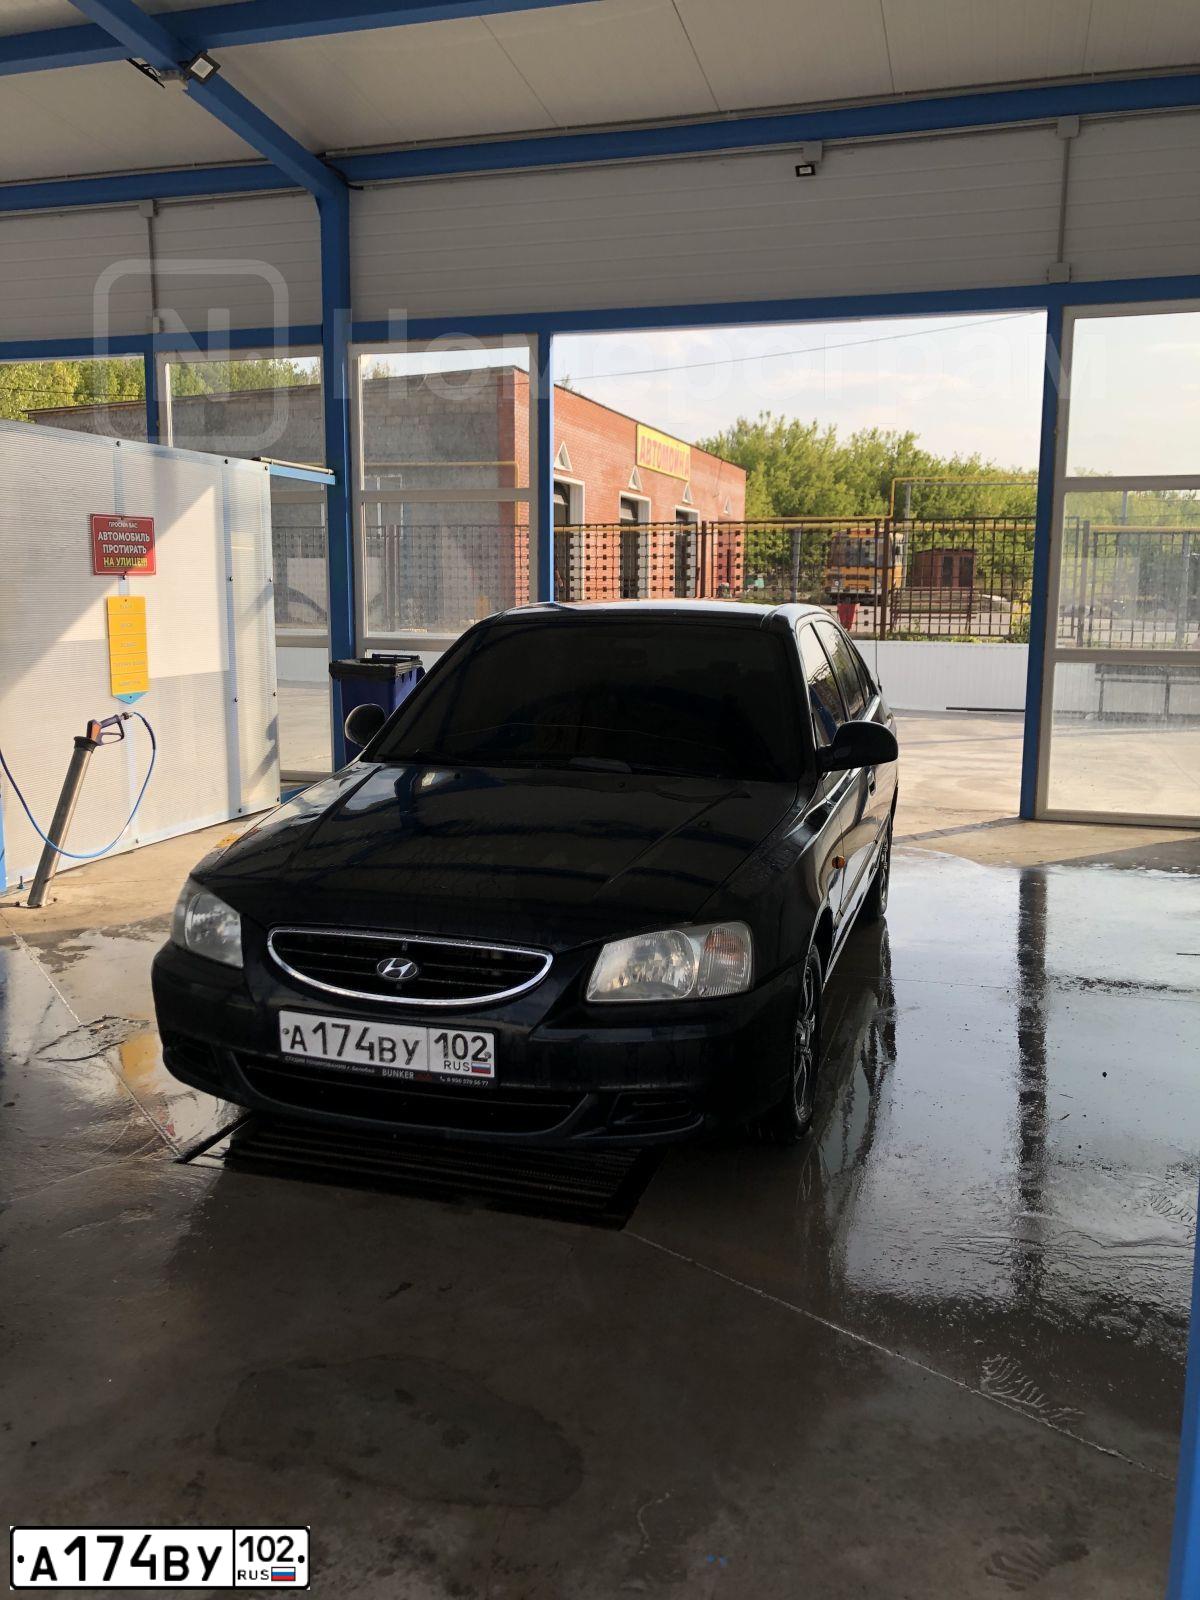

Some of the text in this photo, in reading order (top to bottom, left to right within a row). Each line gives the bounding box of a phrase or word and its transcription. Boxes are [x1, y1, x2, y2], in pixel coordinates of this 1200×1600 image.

[98, 532, 150, 542] АВТОМОБИЛЬ
[103, 544, 147, 554] ПРОТИРАТЬ
[104, 557, 114, 567] НА
[289, 1021, 420, 1065] А174ВУ
[434, 1032, 488, 1062] 102
[443, 1060, 470, 1072] RUS
[382, 1067, 414, 1080] BUNKER
